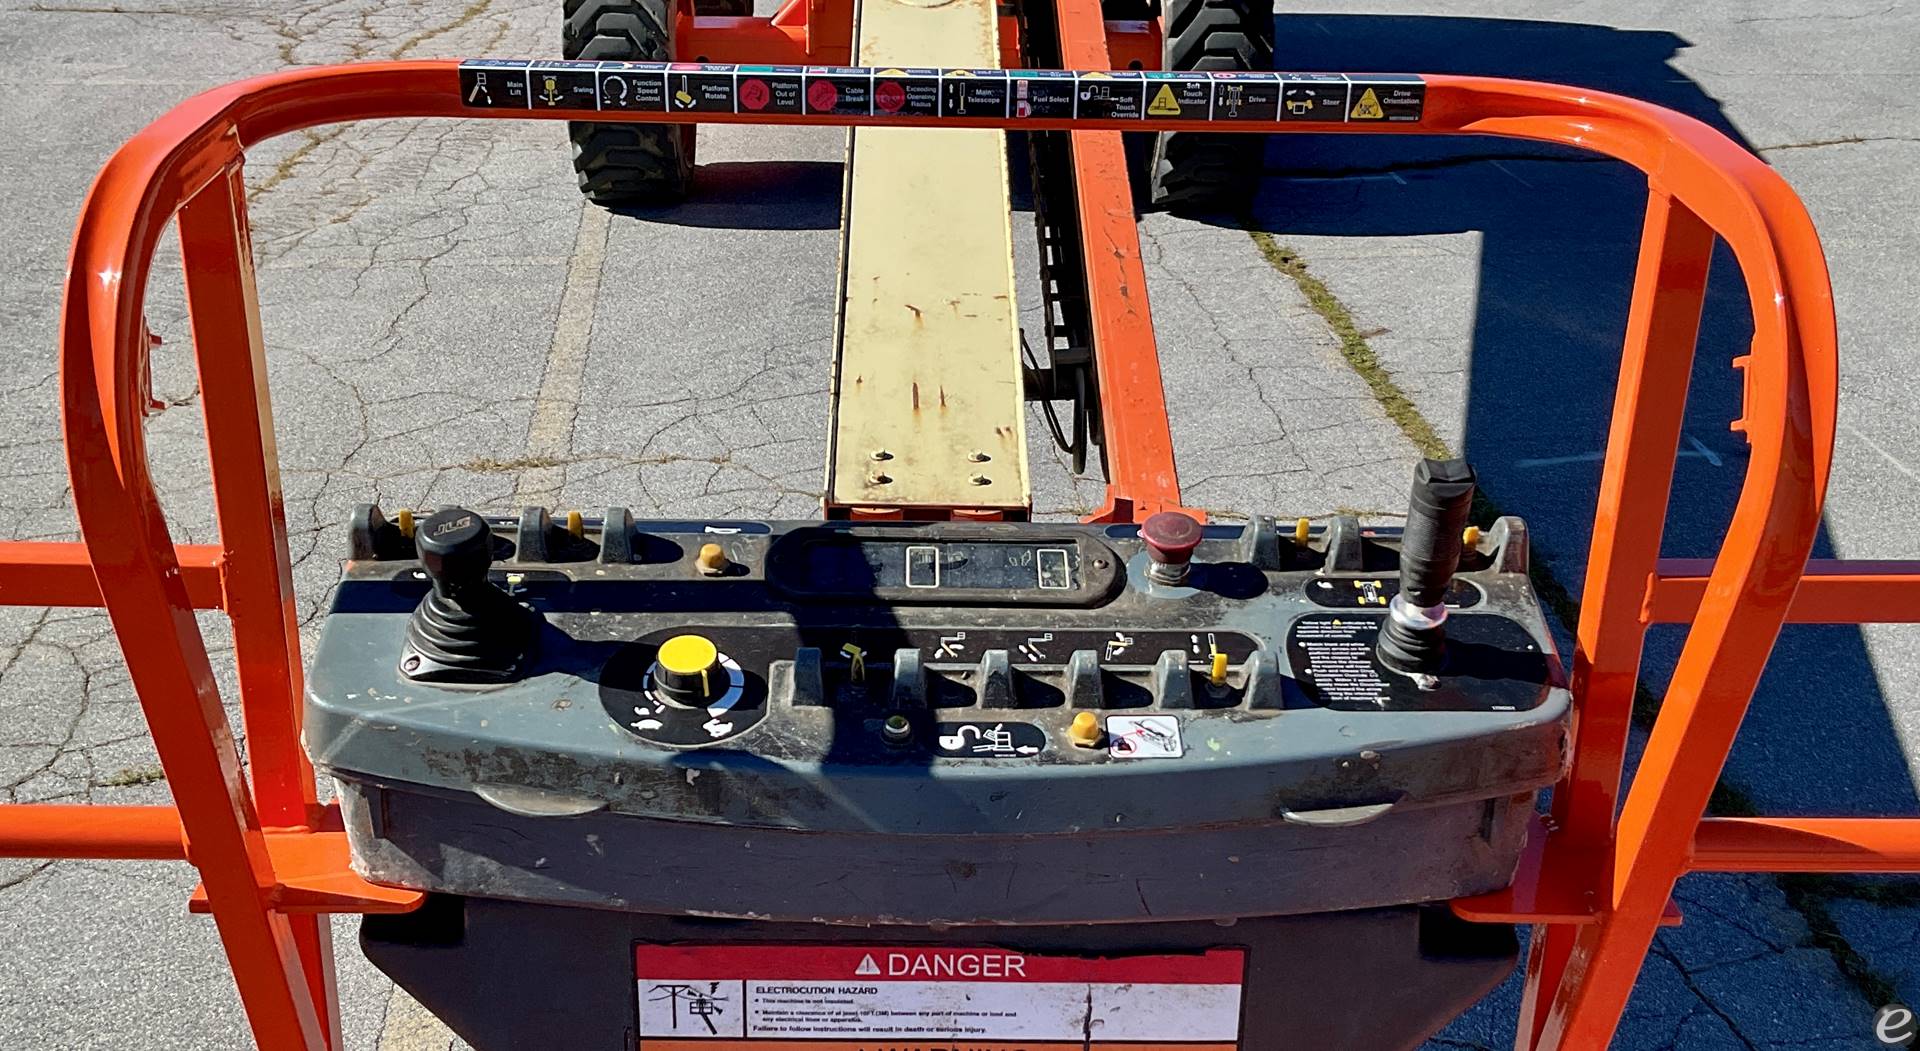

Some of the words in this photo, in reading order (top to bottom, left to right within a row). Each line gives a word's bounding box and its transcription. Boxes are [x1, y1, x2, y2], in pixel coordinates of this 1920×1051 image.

[632, 79, 662, 87] Function
[510, 88, 521, 96] Lift
[573, 86, 594, 95] Swing
[637, 87, 658, 95] Speed
[701, 84, 730, 92] Platform
[905, 85, 937, 93] Exceeding
[705, 92, 727, 100] Rotate
[906, 93, 936, 102] Operating
[967, 96, 1001, 104] Telescope
[777, 98, 795, 106] Level
[1177, 97, 1207, 105] Indicator
[1115, 103, 1136, 111] Touch
[433, 516, 471, 536] JLG
[888, 953, 1026, 977] DANGER
[755, 986, 835, 995] ELECTROCUTION
[838, 986, 878, 995] HAZARD
[964, 1026, 986, 1034] injury.
